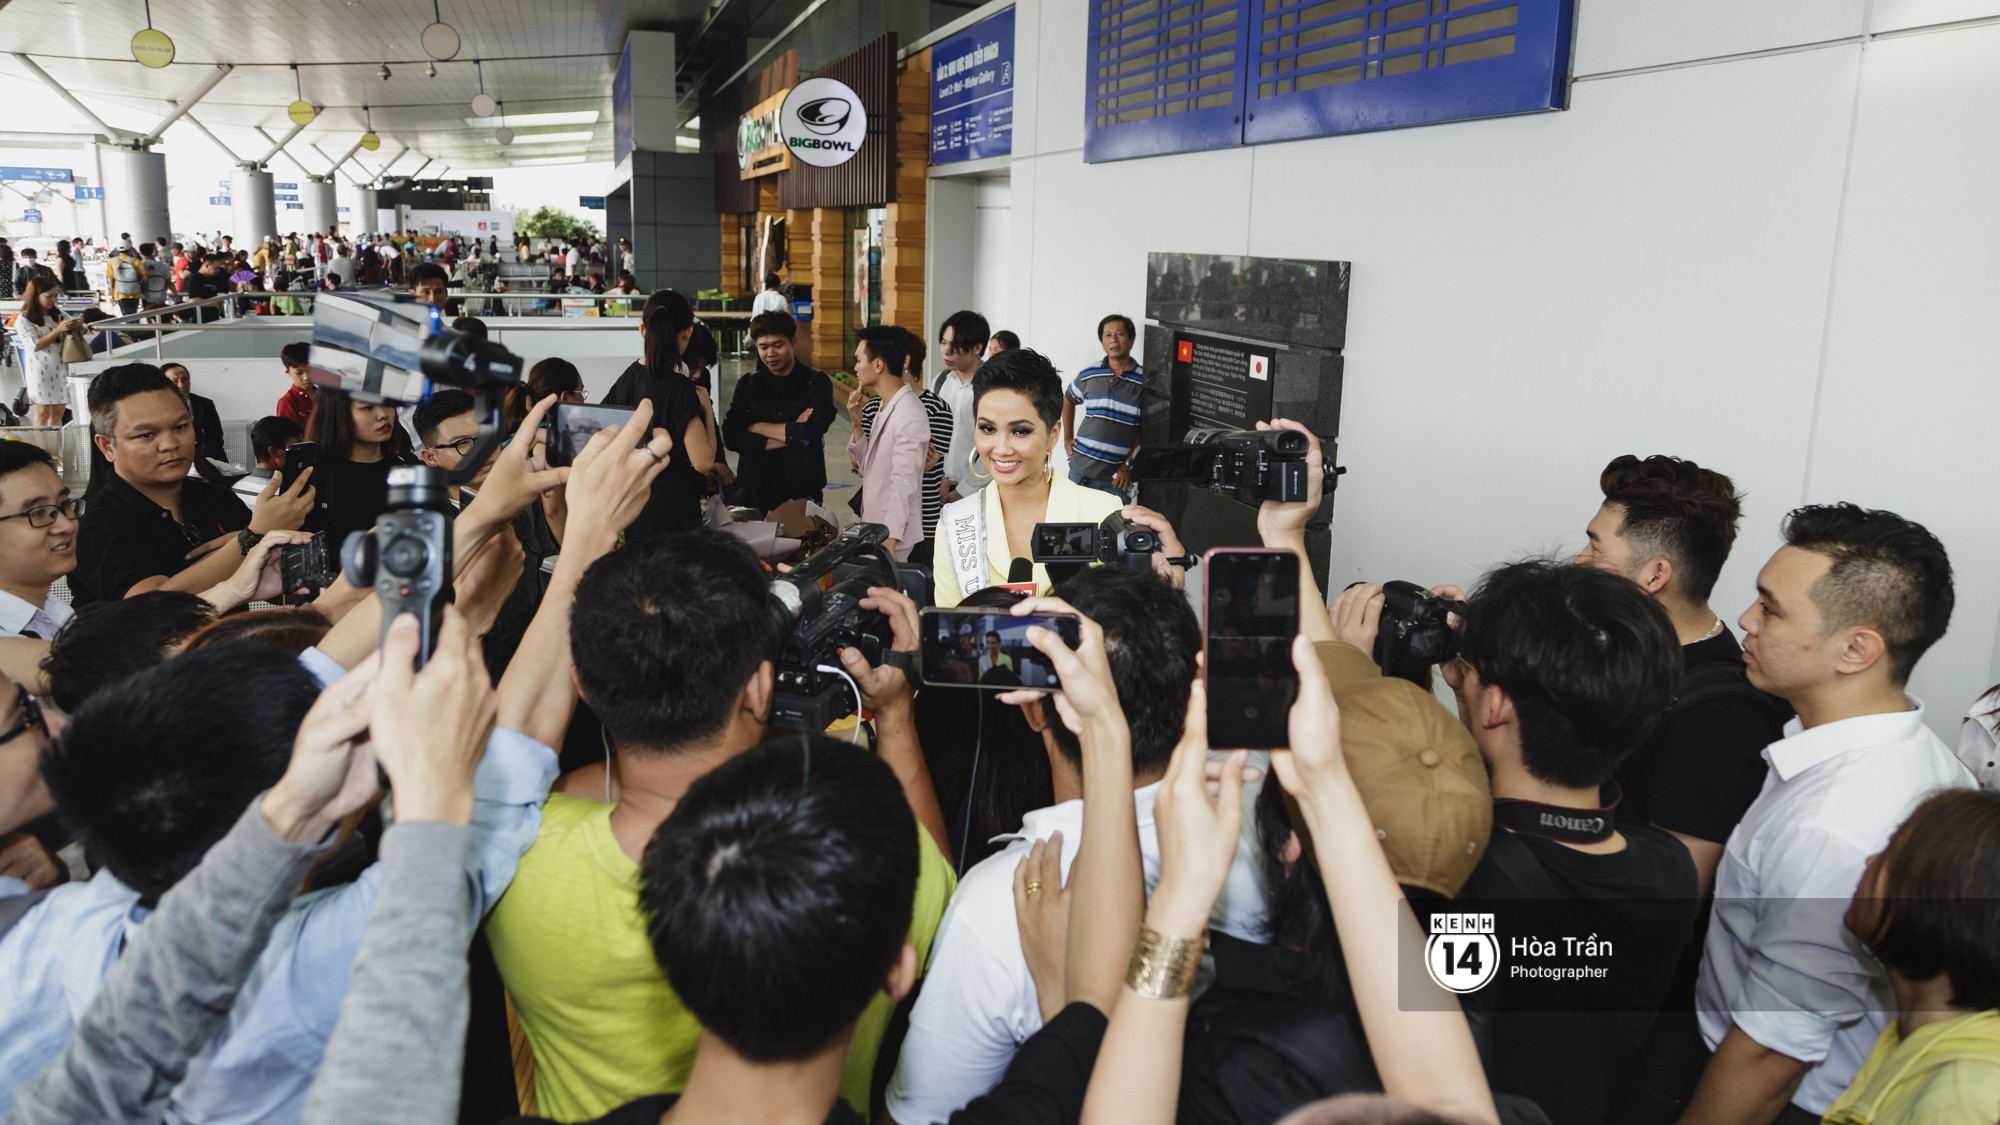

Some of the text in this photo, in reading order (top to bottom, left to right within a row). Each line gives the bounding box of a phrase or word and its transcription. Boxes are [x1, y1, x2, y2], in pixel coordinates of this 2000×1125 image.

[789, 137, 855, 152] BIGBOWL
[955, 514, 977, 572] MISS
[1540, 813, 1604, 833] Canon
